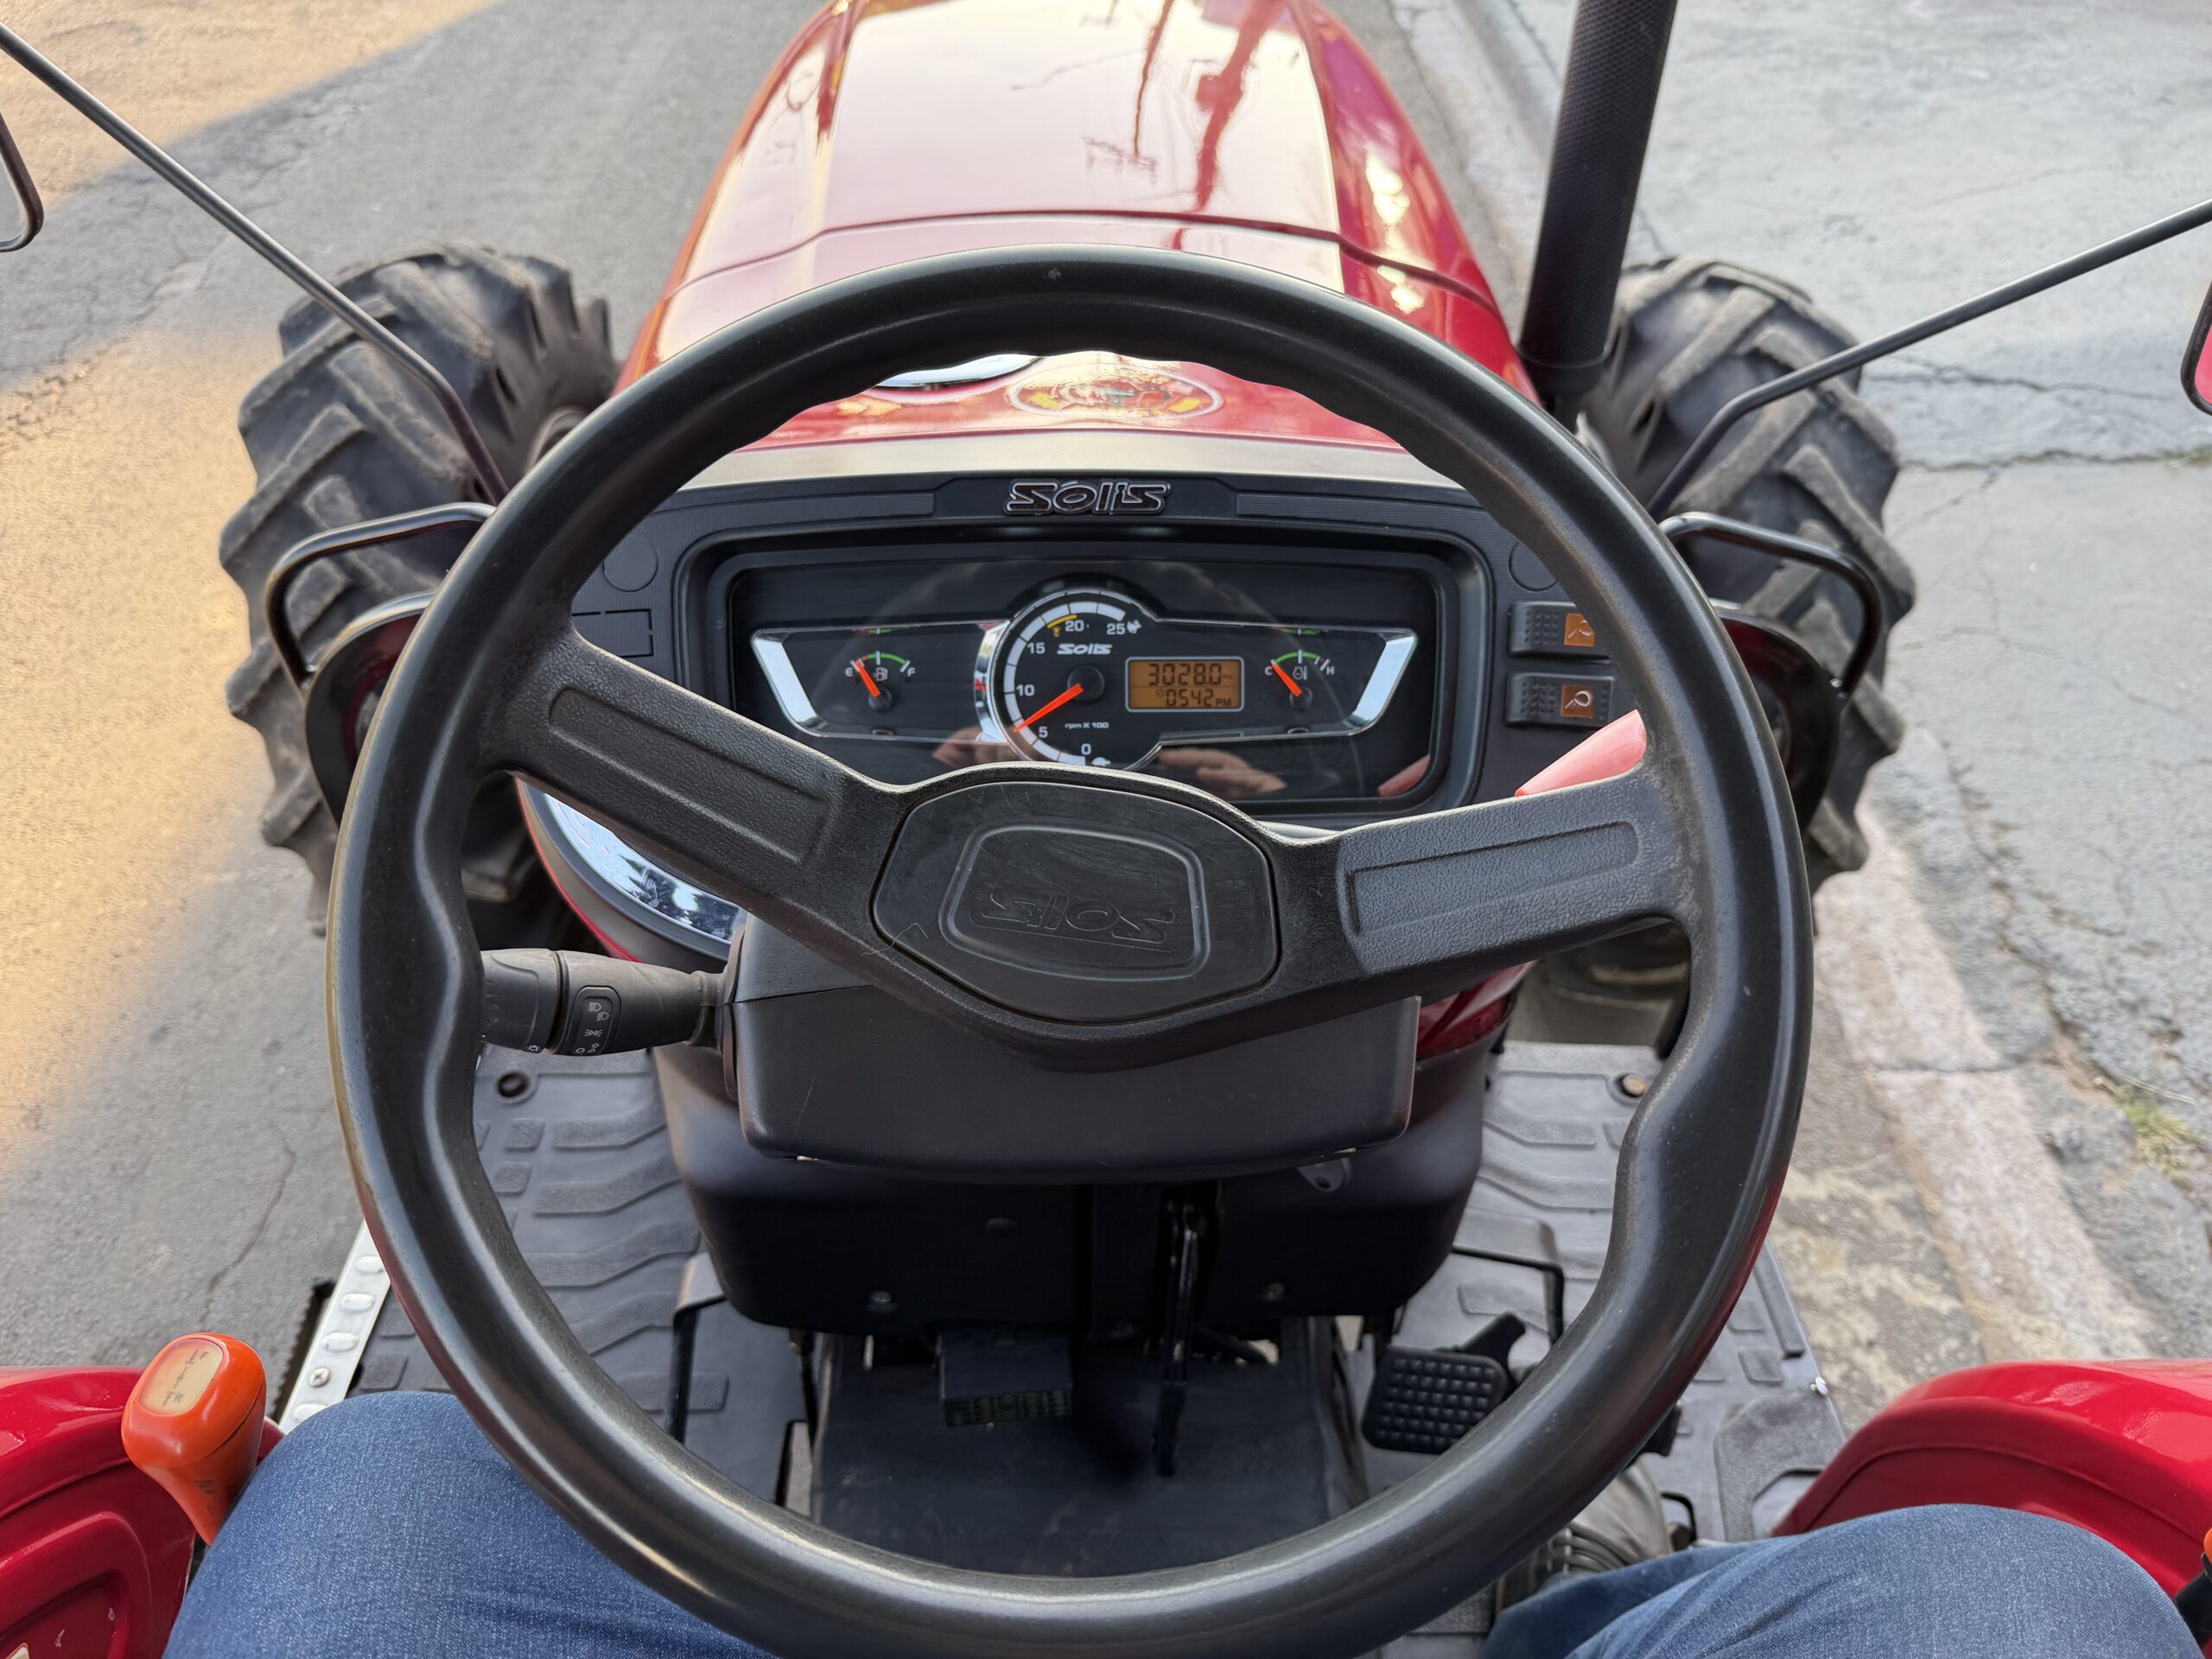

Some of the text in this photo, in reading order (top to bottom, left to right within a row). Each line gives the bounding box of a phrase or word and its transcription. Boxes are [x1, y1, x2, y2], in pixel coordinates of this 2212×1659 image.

[1065, 620, 1084, 632] 20
[1107, 622, 1125, 635] 25
[1027, 642, 1046, 654] 15
[845, 667, 854, 677] E
[906, 667, 916, 677] F
[1264, 666, 1273, 676] C
[1325, 666, 1335, 676] H
[1016, 684, 1035, 696] 10
[1215, 697, 1231, 706] PM
[1039, 727, 1048, 738] 5
[1081, 743, 1091, 755] 0
